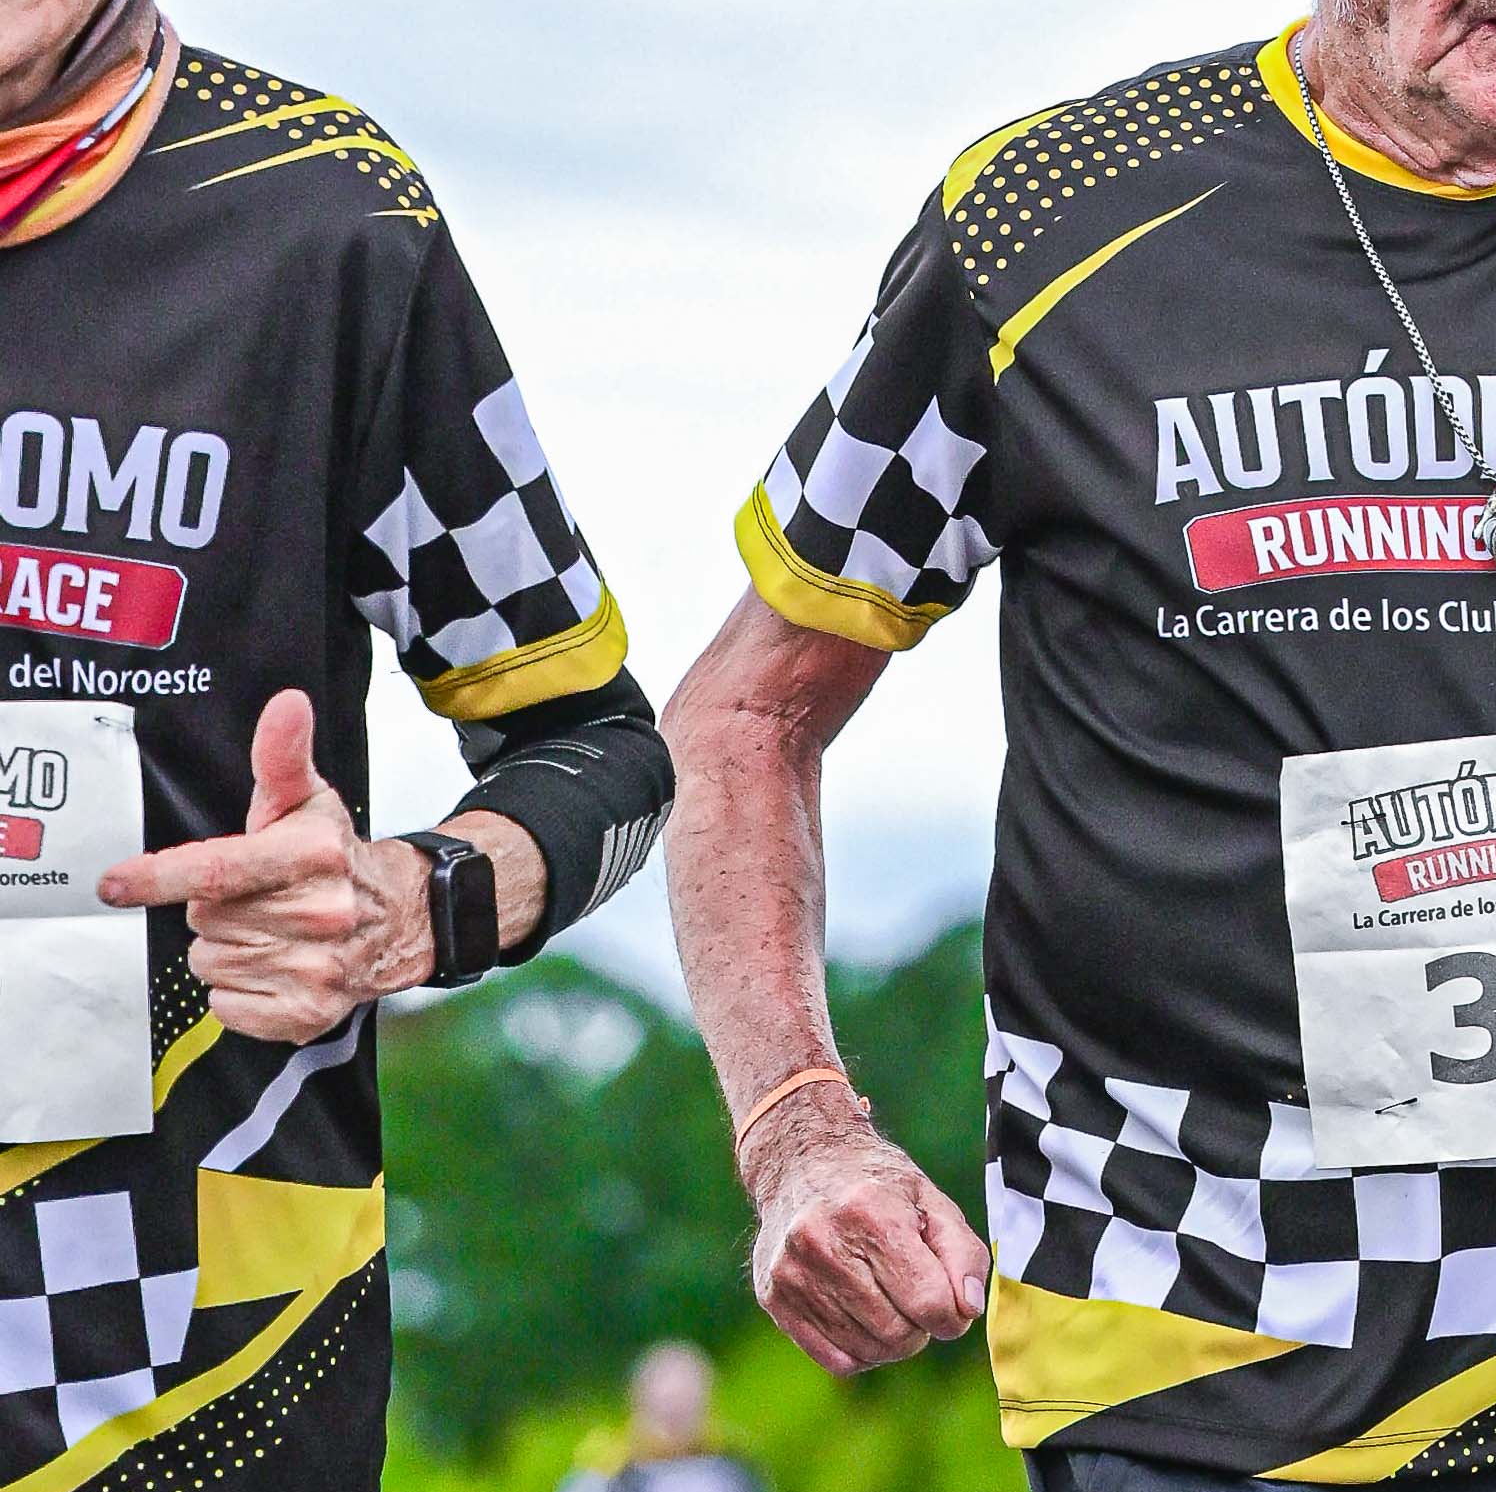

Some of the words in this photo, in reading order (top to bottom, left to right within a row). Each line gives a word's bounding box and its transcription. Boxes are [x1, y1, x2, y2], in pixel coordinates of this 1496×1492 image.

[0, 556, 121, 633] ACE
[1157, 606, 1189, 638] La
[1195, 604, 1319, 637] Carrera
[1329, 597, 1372, 632] de
[1381, 598, 1431, 632] los
[8, 653, 61, 689] del
[72, 659, 212, 696] Noroeste
[1353, 912, 1374, 930] La
[1378, 906, 1446, 927] Carrera
[1451, 899, 1474, 918] de
